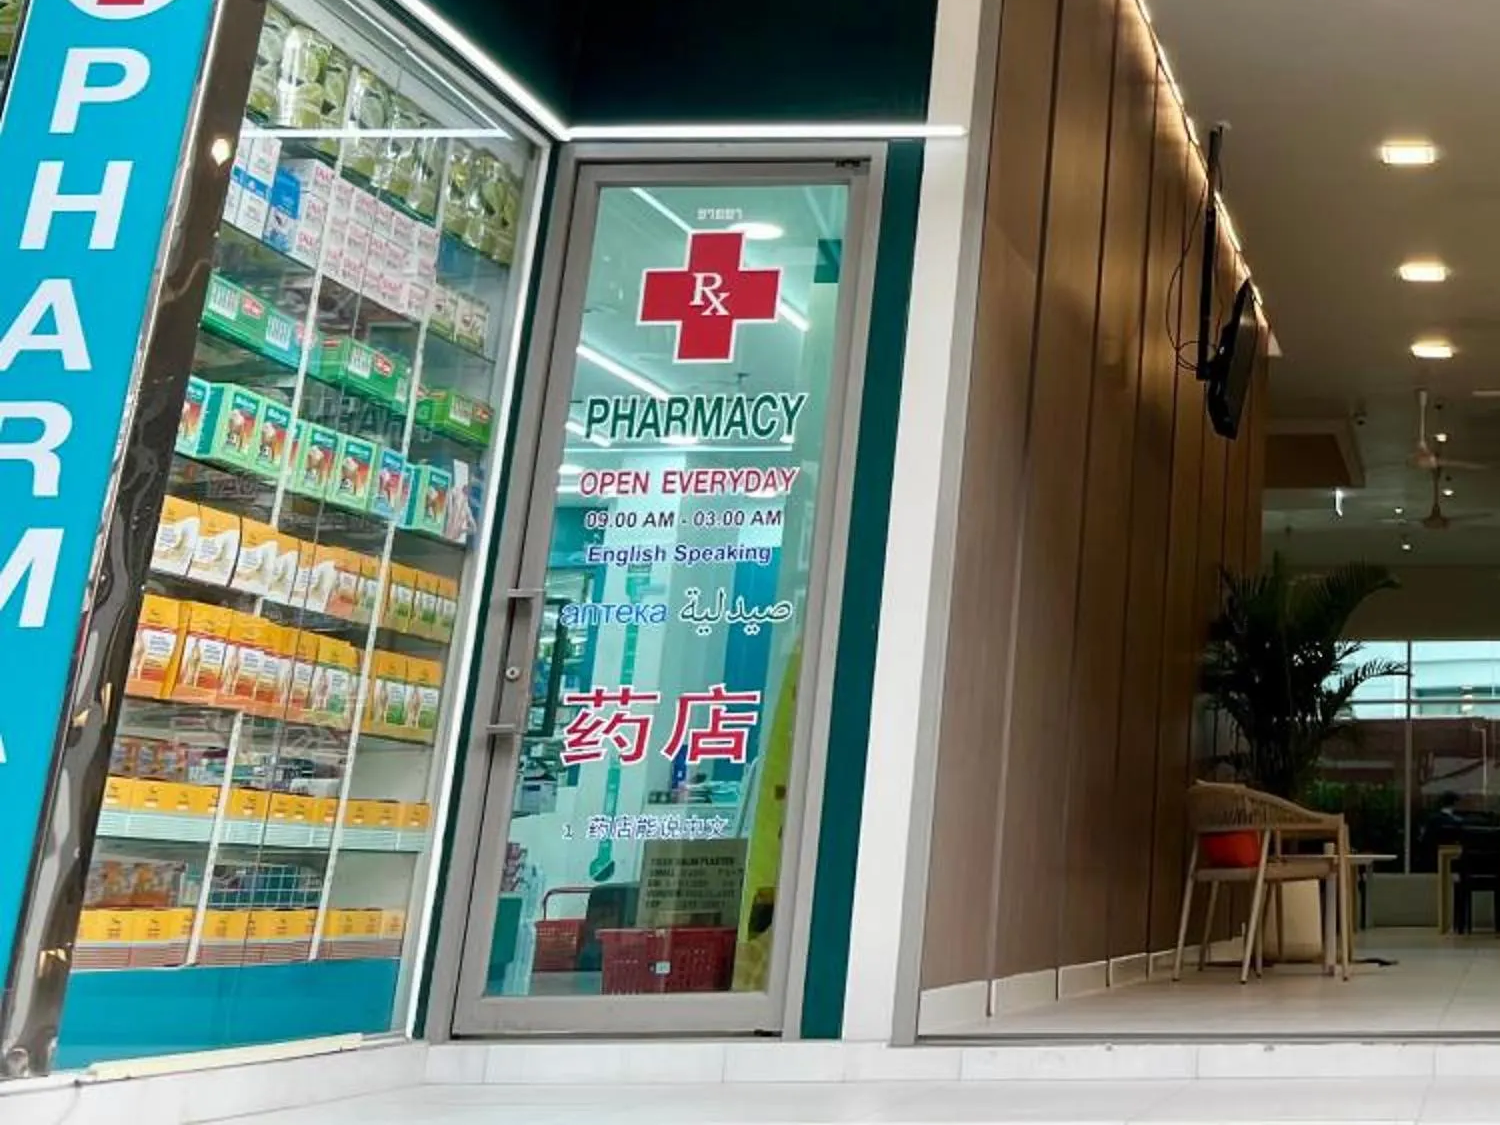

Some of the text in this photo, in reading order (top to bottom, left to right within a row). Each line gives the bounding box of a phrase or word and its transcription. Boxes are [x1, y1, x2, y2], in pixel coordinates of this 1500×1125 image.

[584, 393, 807, 440] PHARMACY
[580, 467, 800, 495] OPEN EVERYDAY
[642, 511, 675, 528] AM
[750, 509, 782, 526] AM
[587, 543, 772, 567] English Speaking
[561, 602, 668, 625] аптека
[678, 587, 794, 635] صيدلية
[561, 683, 762, 766] 药店
